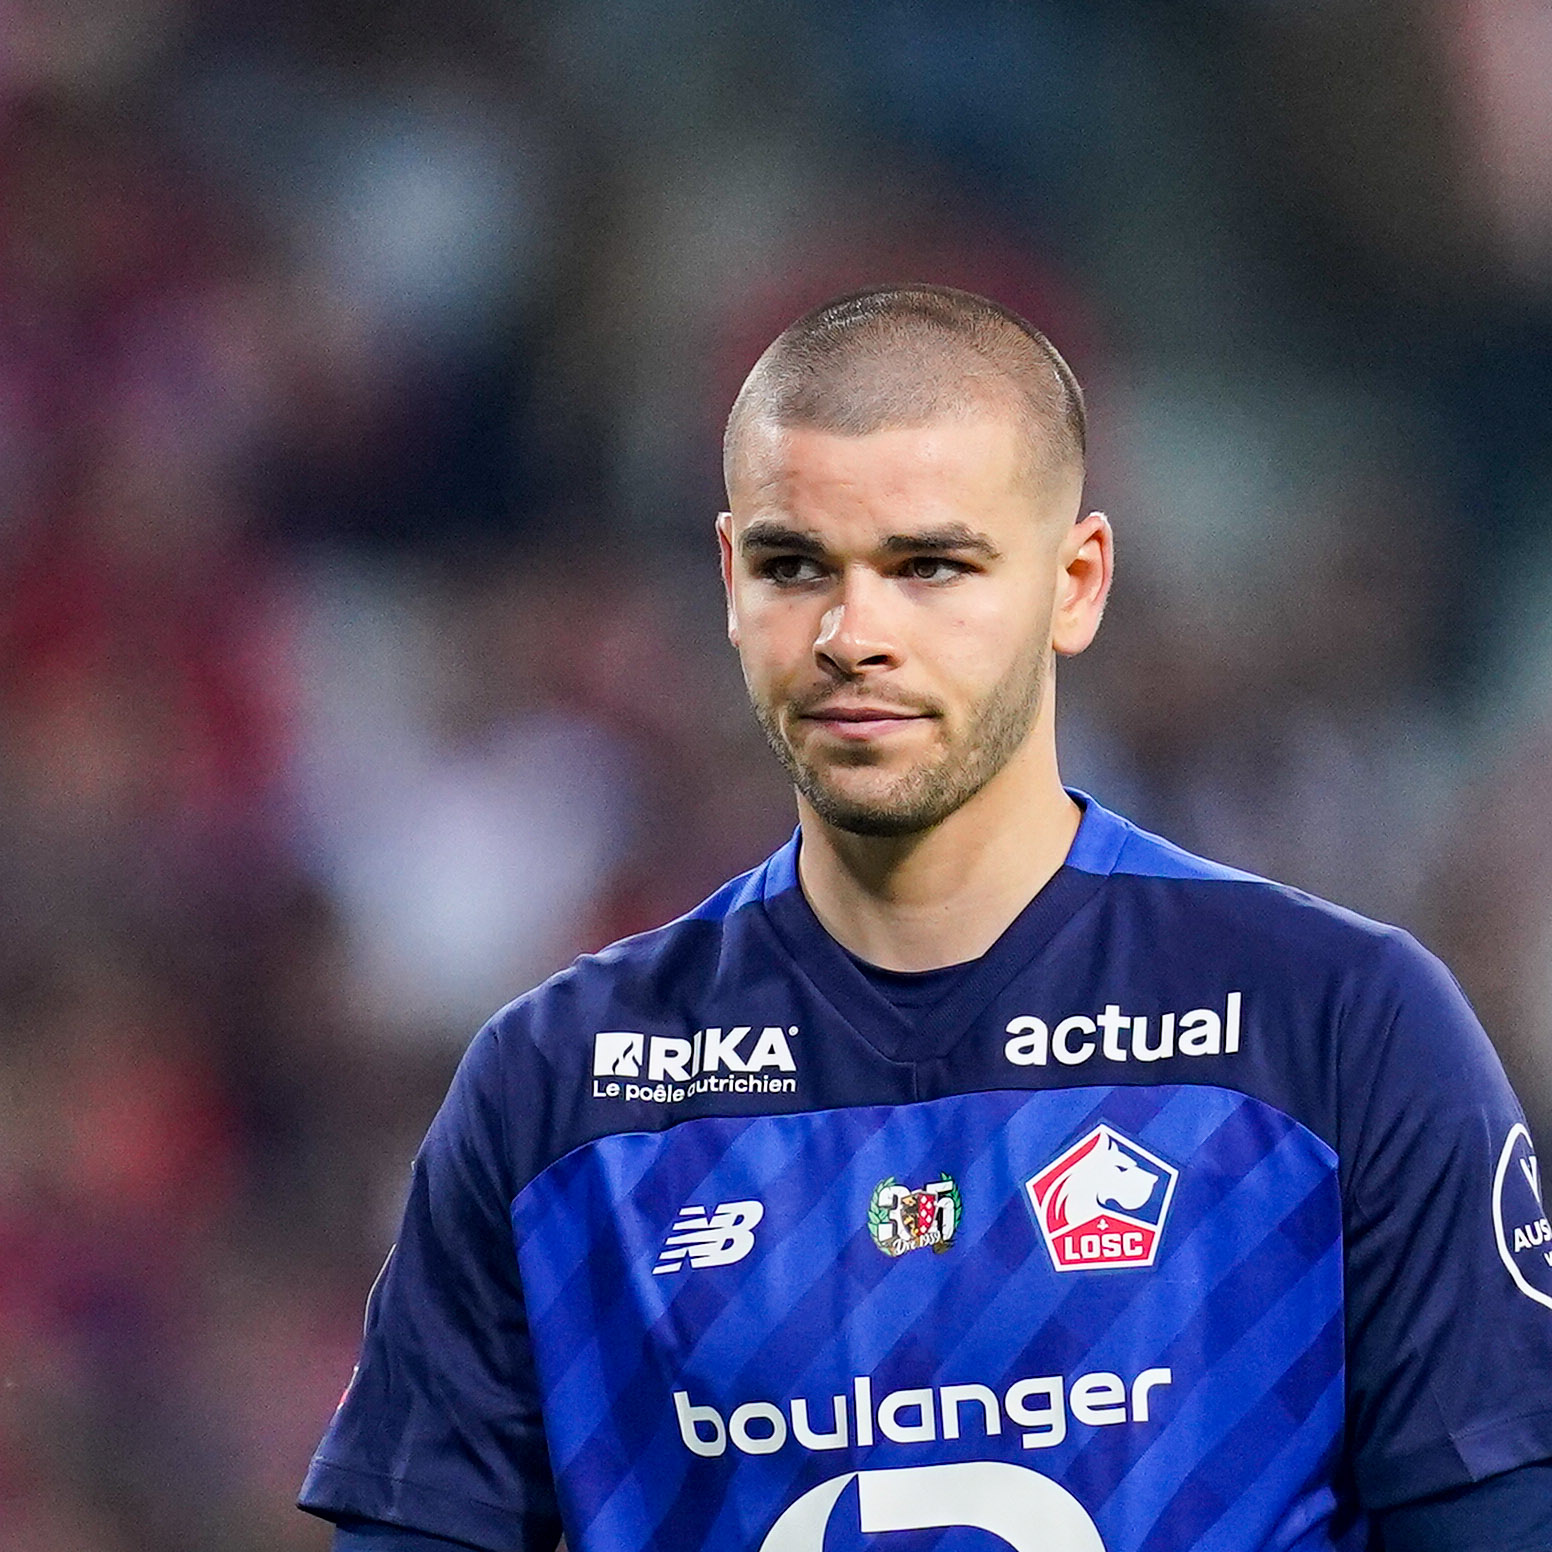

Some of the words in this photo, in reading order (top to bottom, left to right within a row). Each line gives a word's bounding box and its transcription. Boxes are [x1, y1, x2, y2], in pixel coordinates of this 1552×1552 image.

[647, 1026, 797, 1082] RIKA
[1005, 992, 1242, 1066] actual
[593, 1080, 620, 1097] Le
[625, 1083, 686, 1103] poêle
[687, 1075, 796, 1098] autrichien
[1064, 1231, 1144, 1261] LOSC
[673, 1367, 1173, 1458] boulanger
